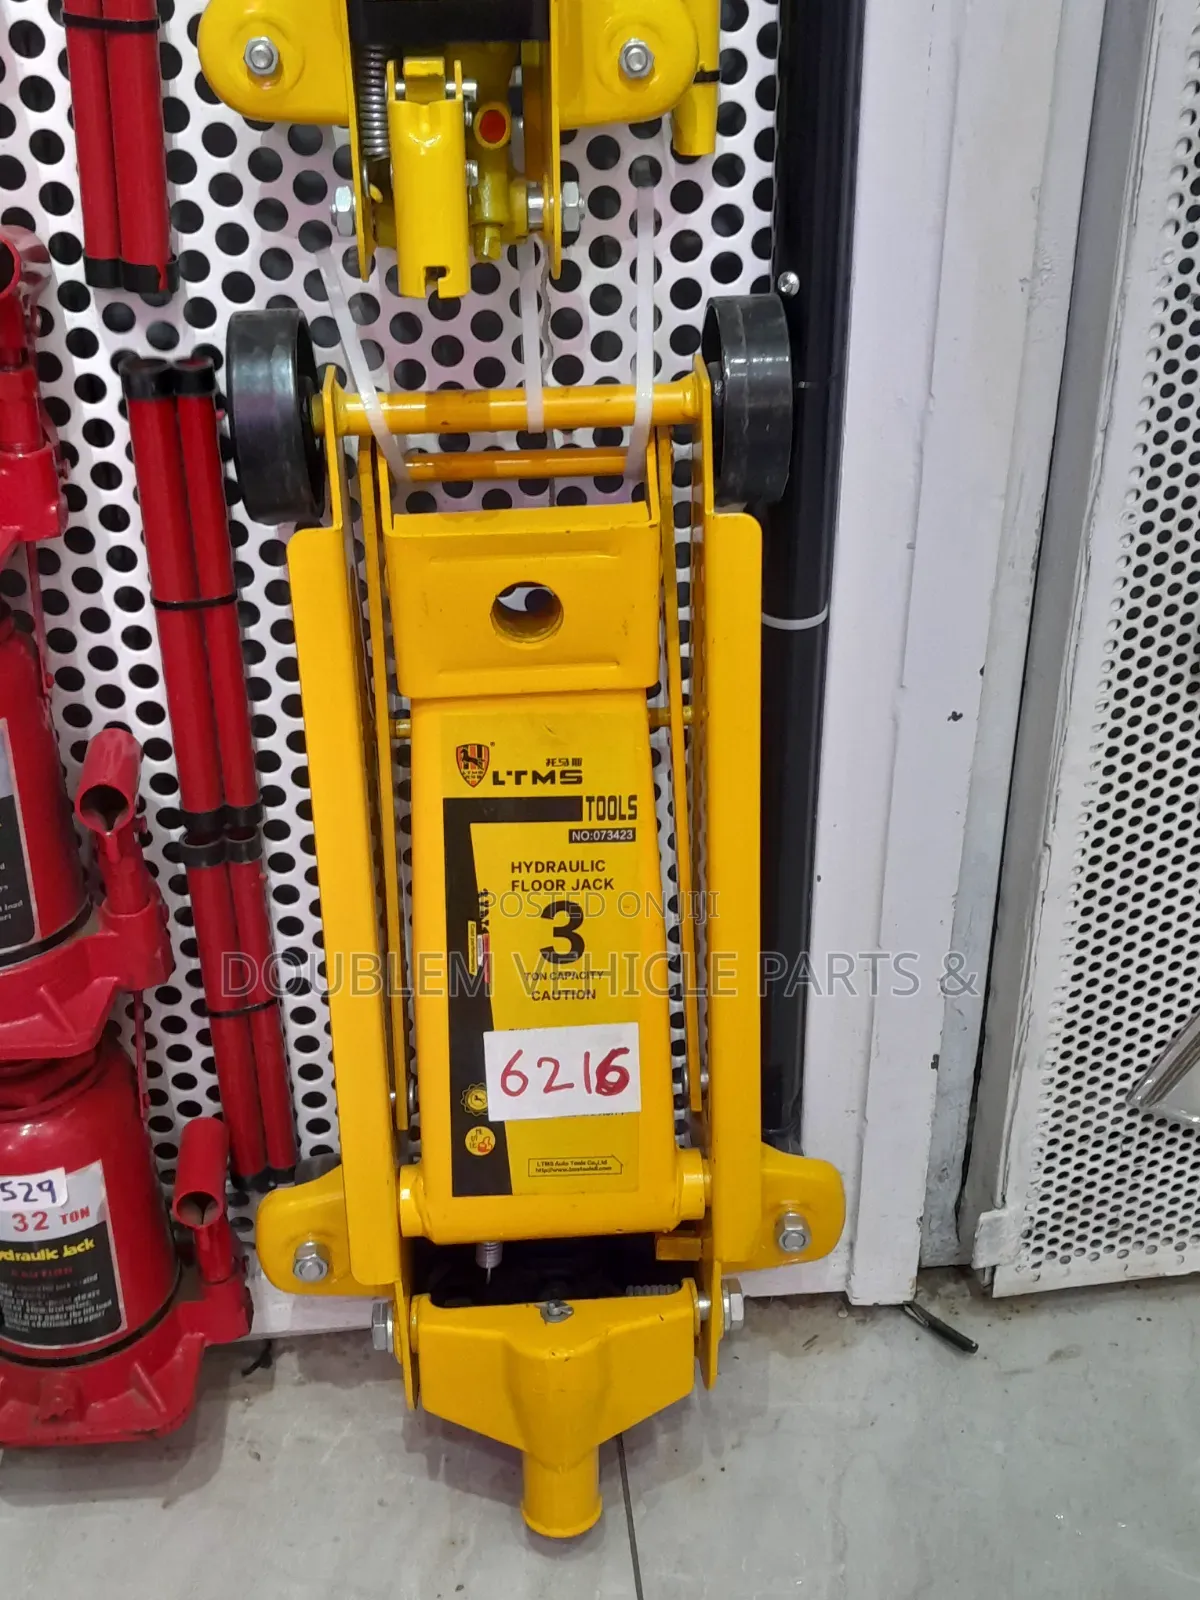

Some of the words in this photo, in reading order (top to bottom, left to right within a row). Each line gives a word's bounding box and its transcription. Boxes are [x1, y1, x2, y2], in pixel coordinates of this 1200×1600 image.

[492, 769, 583, 786] LTMS
[585, 794, 638, 821] TOOLS
[571, 828, 634, 842] NO:073423
[511, 859, 606, 874] HYDRAULIC
[511, 879, 566, 892] FLOOR
[571, 878, 615, 891] JACK
[539, 900, 586, 965] 3
[549, 970, 605, 981] CAPACITY
[531, 989, 596, 1002] CAUTION
[500, 1046, 630, 1098] 6216
[12, 1210, 50, 1232] 32
[59, 1206, 91, 1225] TON
